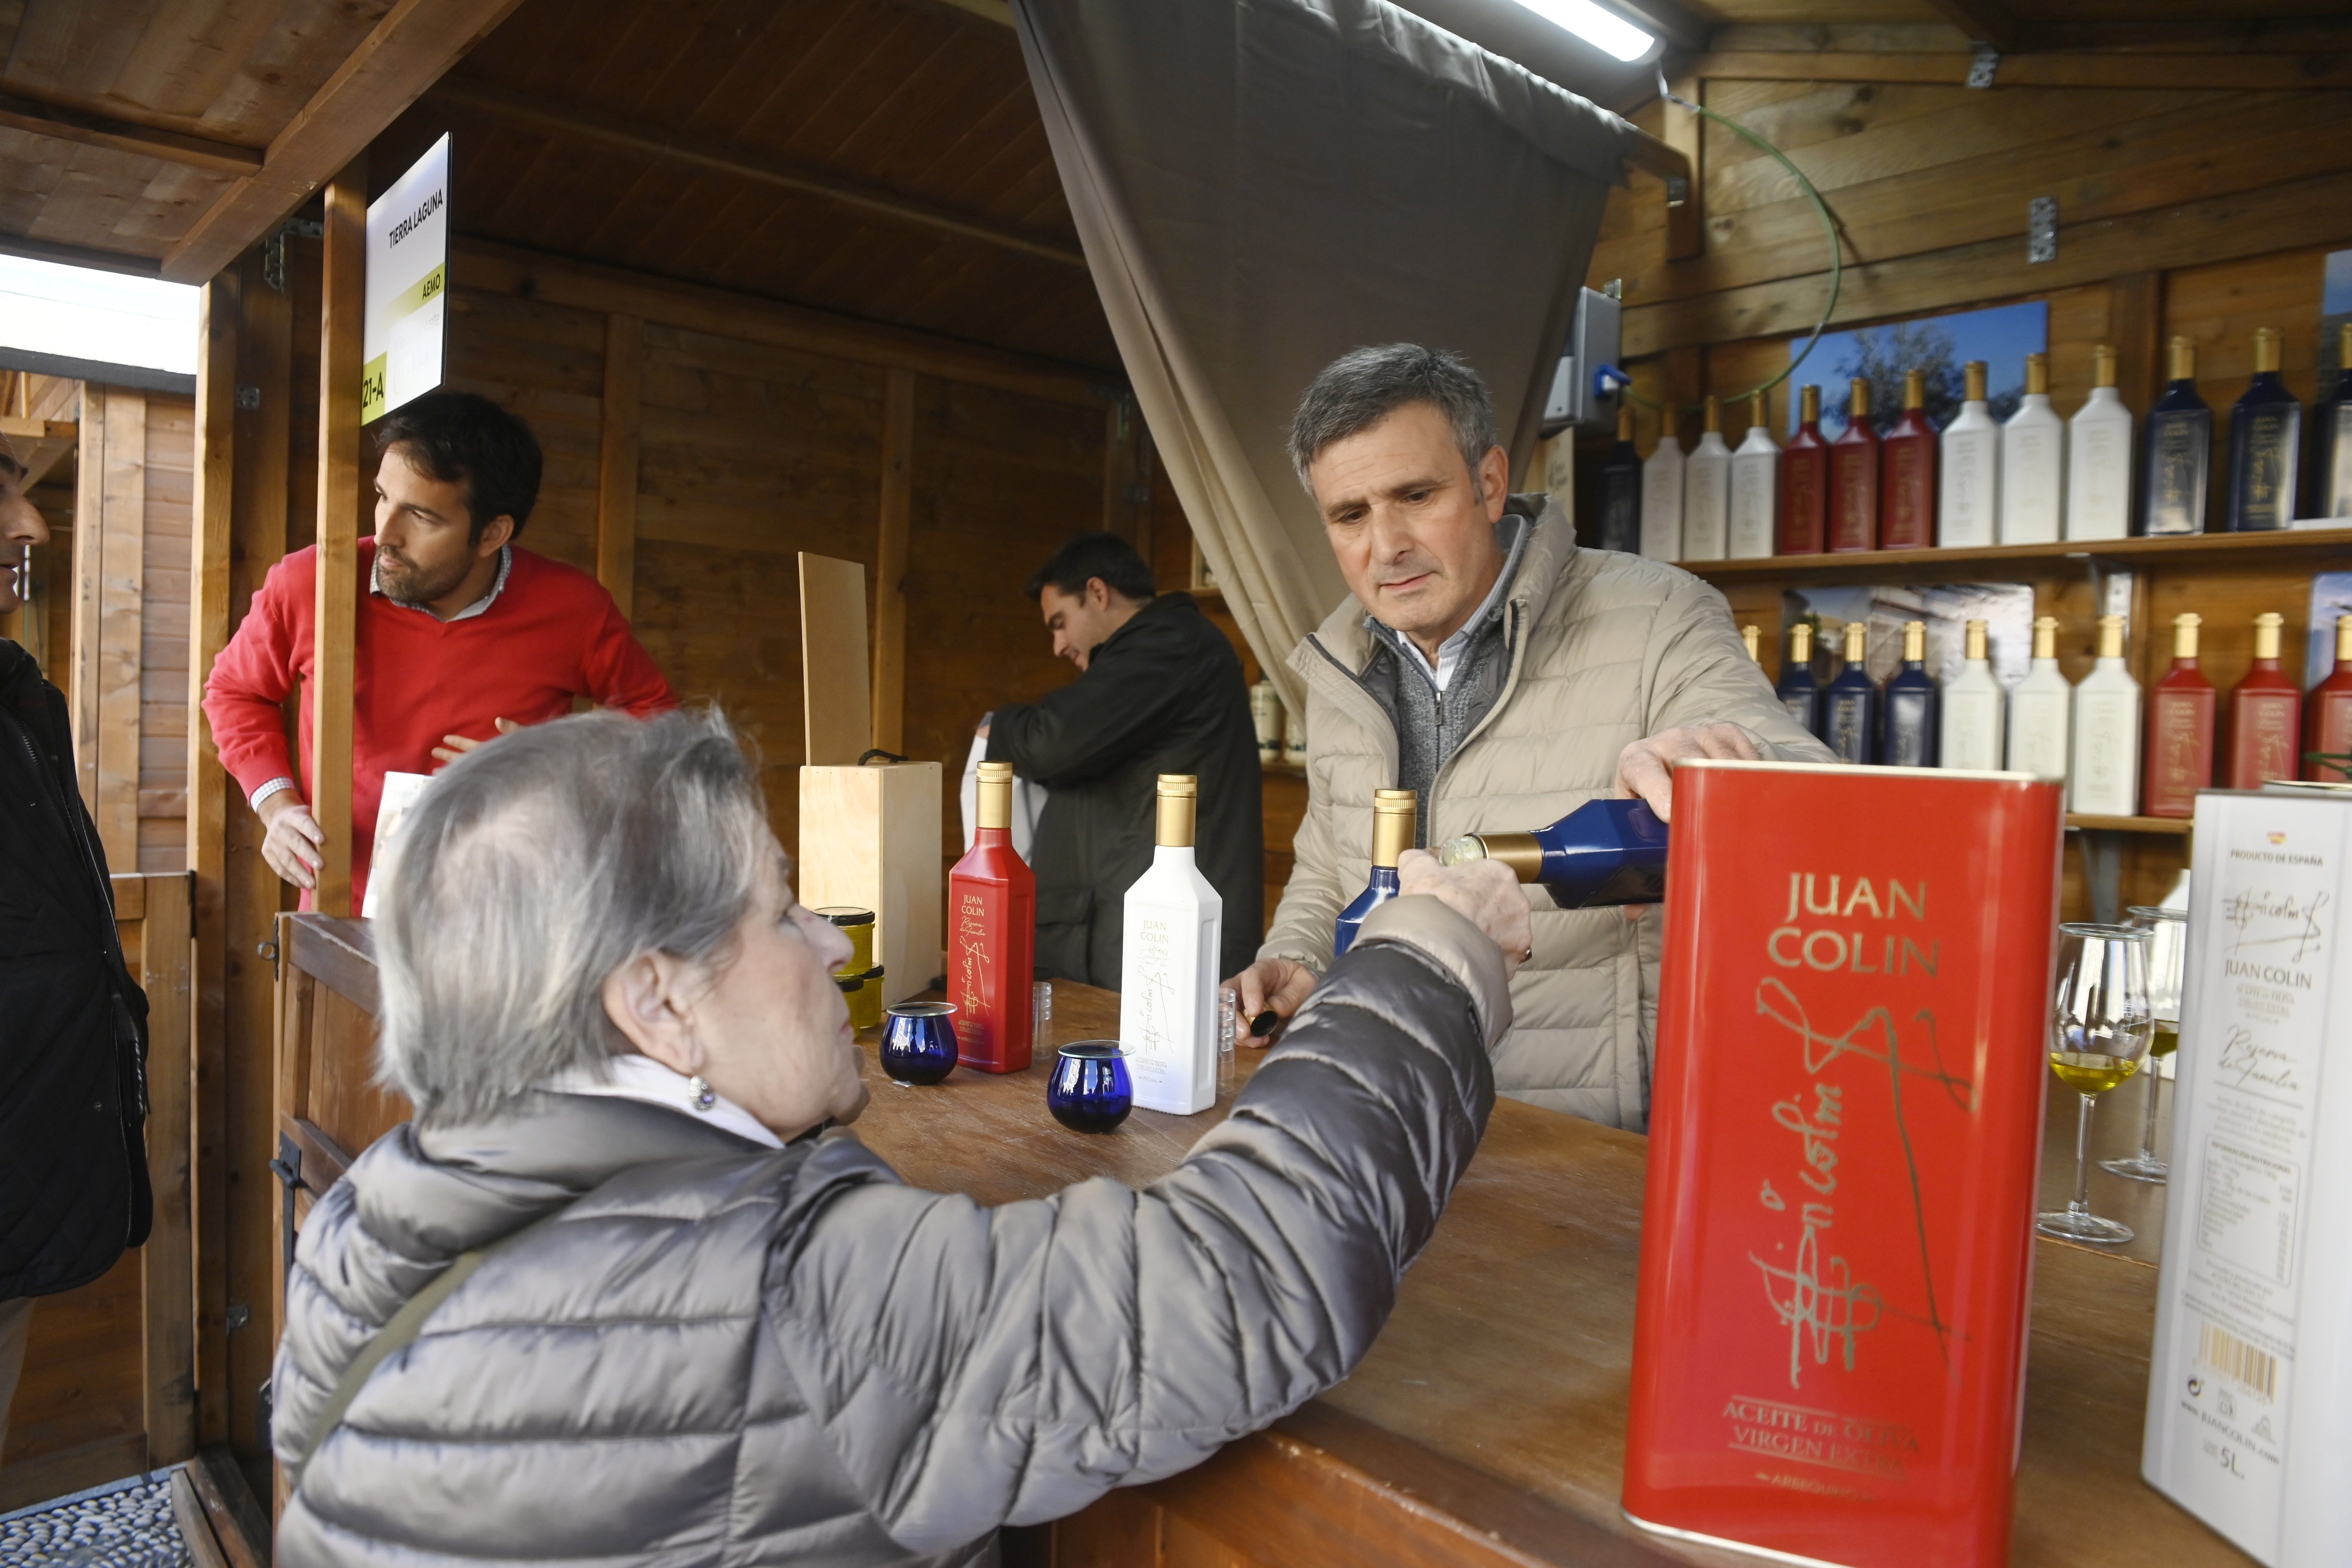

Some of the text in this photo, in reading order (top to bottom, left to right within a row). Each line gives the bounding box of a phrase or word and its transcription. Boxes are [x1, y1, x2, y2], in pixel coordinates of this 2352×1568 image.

[389, 188, 443, 249] TIERRA LAGUNA
[422, 273, 440, 301] AEMO
[363, 372, 384, 409] 21-A
[2231, 849, 2323, 866] PRODUCTO DE ESPAÑA
[961, 905, 985, 917] COLIN
[963, 894, 983, 905] JUAN
[1786, 872, 1927, 924] JUAN
[1140, 932, 1169, 944] COLIN
[1143, 920, 1167, 931] JUAN
[1768, 926, 1940, 979] COLIN
[2224, 959, 2312, 989] JUAN COLIN
[1722, 1402, 1920, 1453] ACEITE DE OLIVA
[1734, 1425, 1906, 1474] VIRGEN EXTRA
